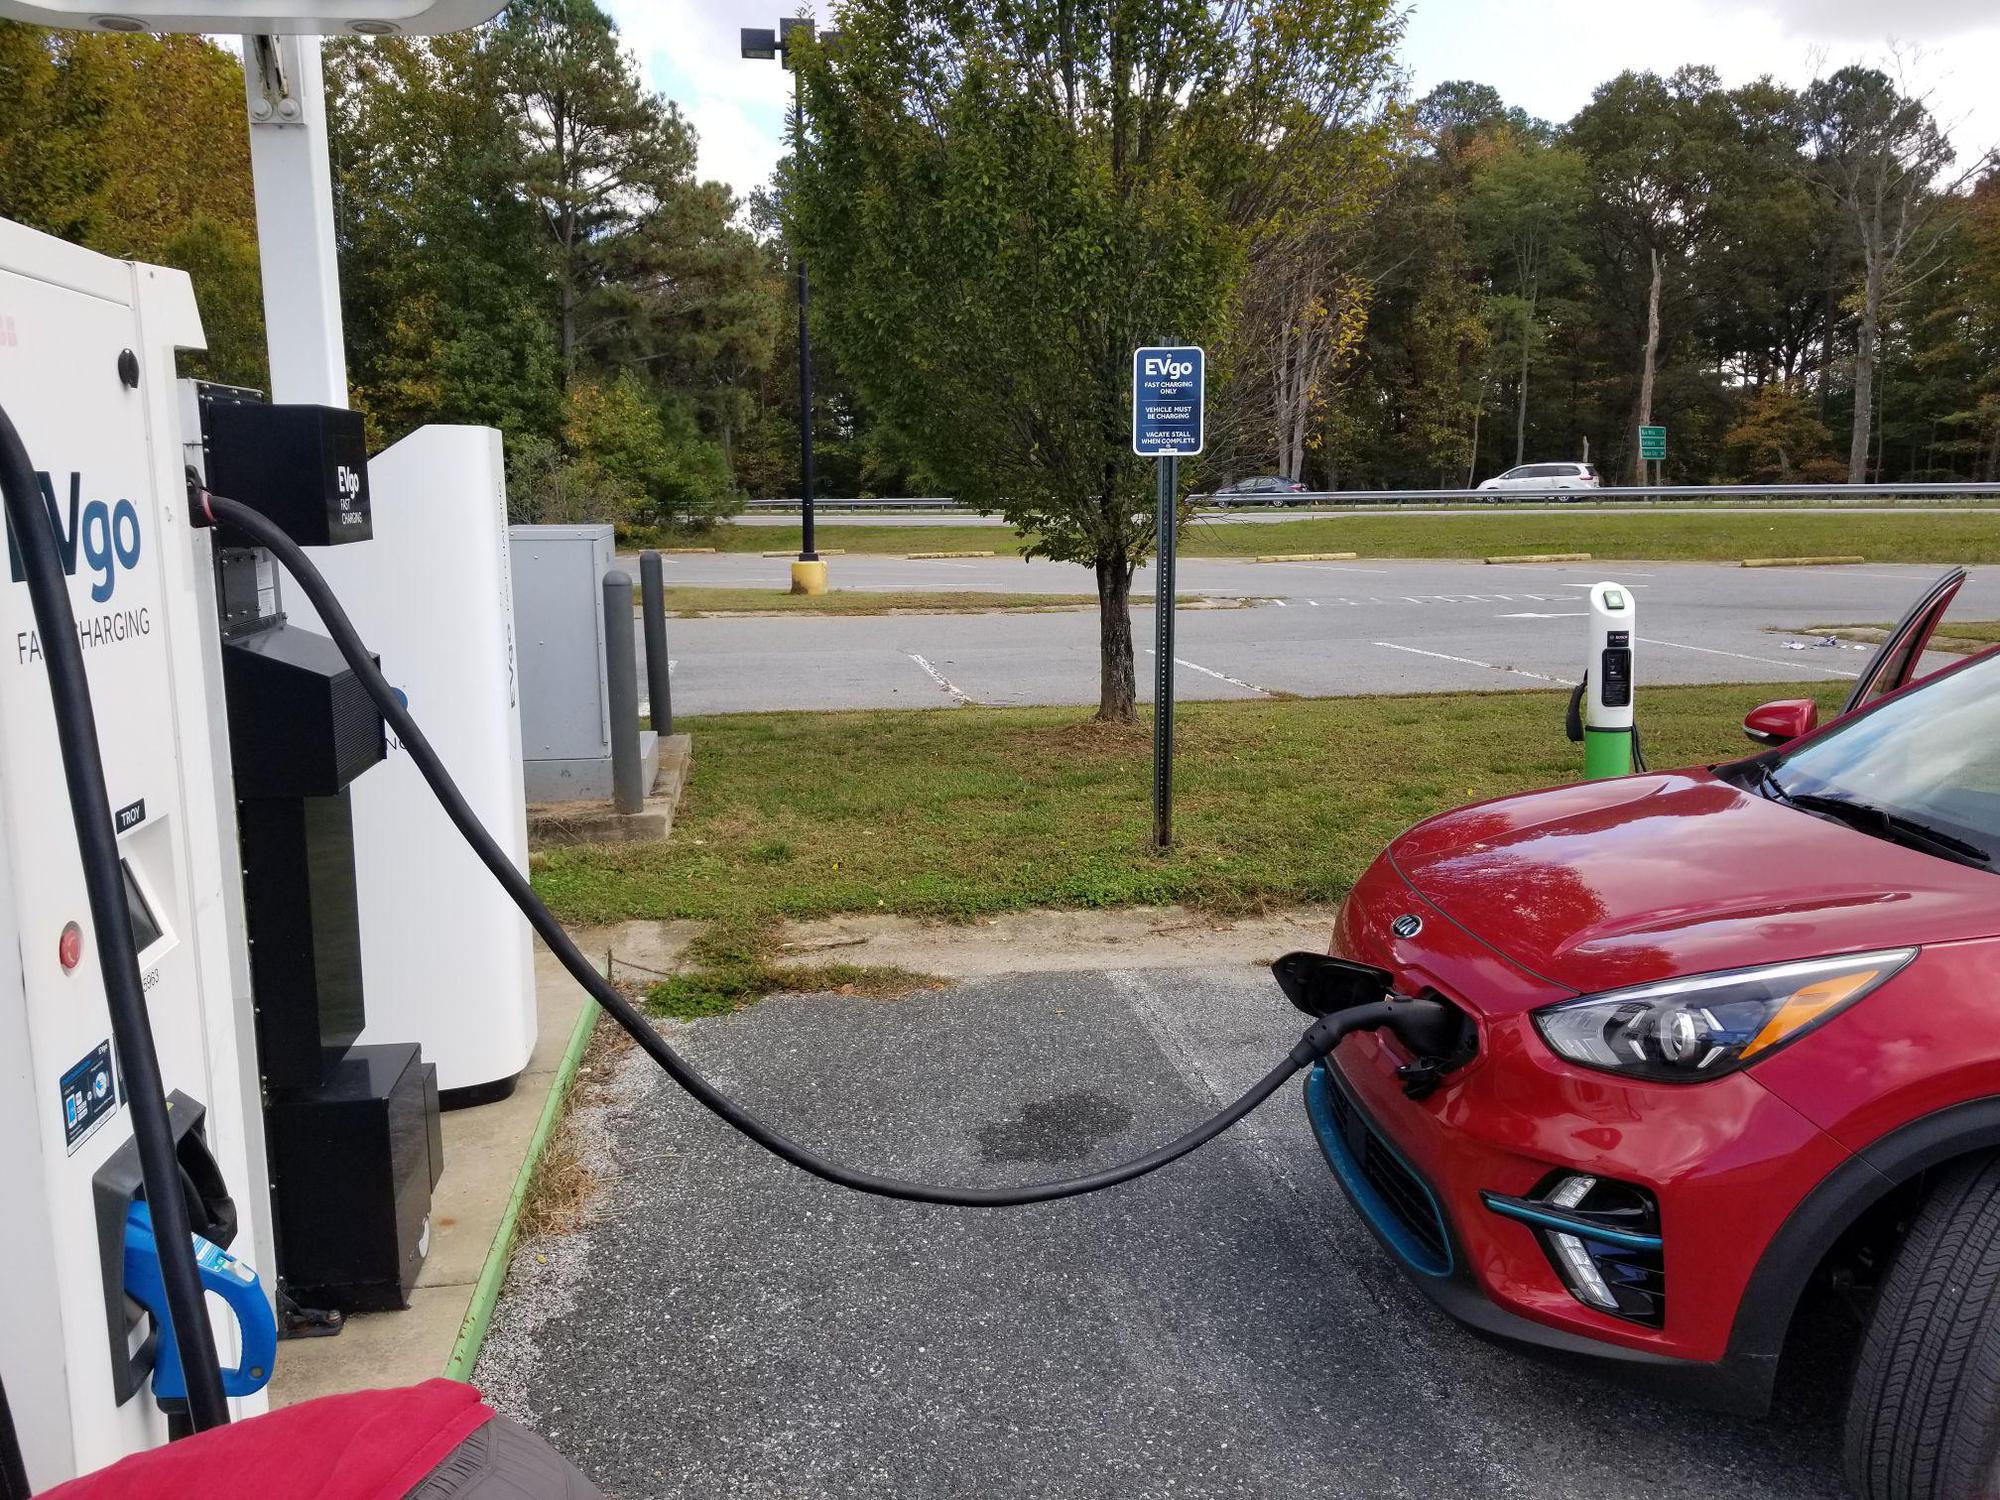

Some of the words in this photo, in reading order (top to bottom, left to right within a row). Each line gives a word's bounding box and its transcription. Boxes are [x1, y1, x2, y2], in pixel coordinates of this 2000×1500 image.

[1145, 358, 1193, 380] EVgo
[338, 466, 359, 499] EVgo
[75, 607, 151, 650] HARGING
[120, 805, 140, 827] TROY
